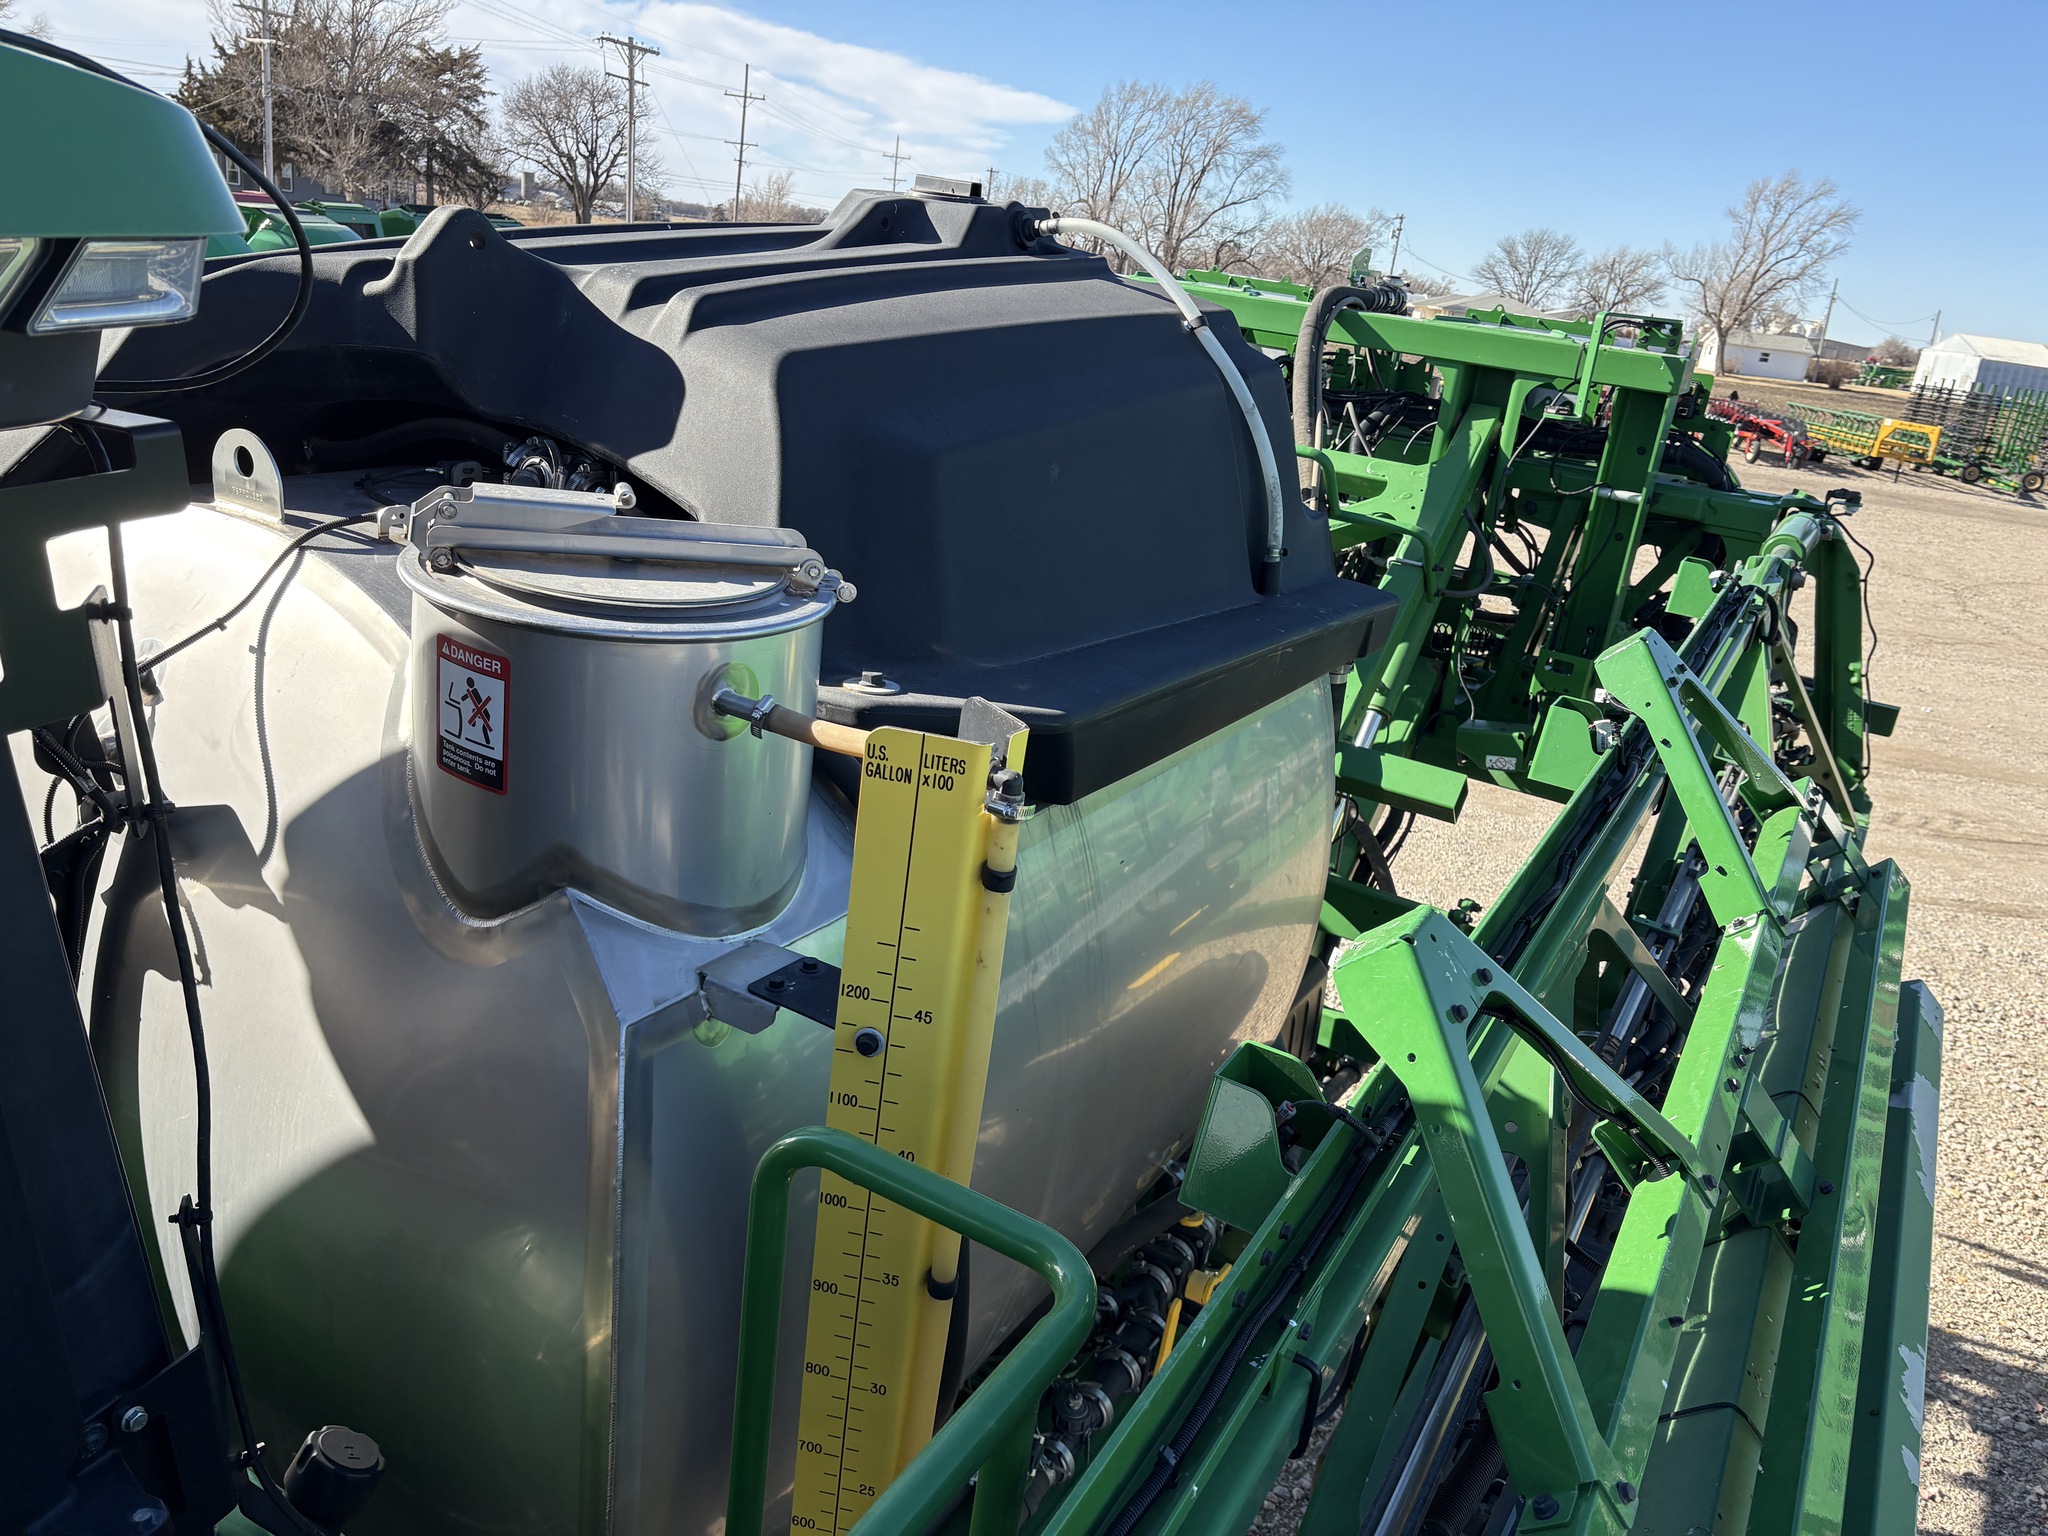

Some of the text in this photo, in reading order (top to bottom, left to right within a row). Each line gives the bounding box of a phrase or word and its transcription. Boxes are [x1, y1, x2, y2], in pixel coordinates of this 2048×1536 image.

[451, 645, 501, 673] DANGER
[443, 740, 496, 768] Tank contents are
[867, 743, 889, 762] U.S.
[442, 749, 496, 776] poisonous. Do not
[442, 757, 472, 775] enter tank.
[924, 753, 967, 775] LITERS
[865, 762, 913, 784] GALLON
[841, 983, 870, 1001] 1200
[914, 1010, 933, 1025] 45
[829, 1091, 858, 1108] 1100
[819, 1192, 847, 1208] 1000
[812, 1279, 838, 1295] 900
[882, 1273, 900, 1287] 35
[805, 1362, 830, 1377] 800
[869, 1382, 887, 1396] 30
[798, 1439, 823, 1454] 700
[858, 1484, 876, 1498] 25
[791, 1516, 815, 1530] 600
